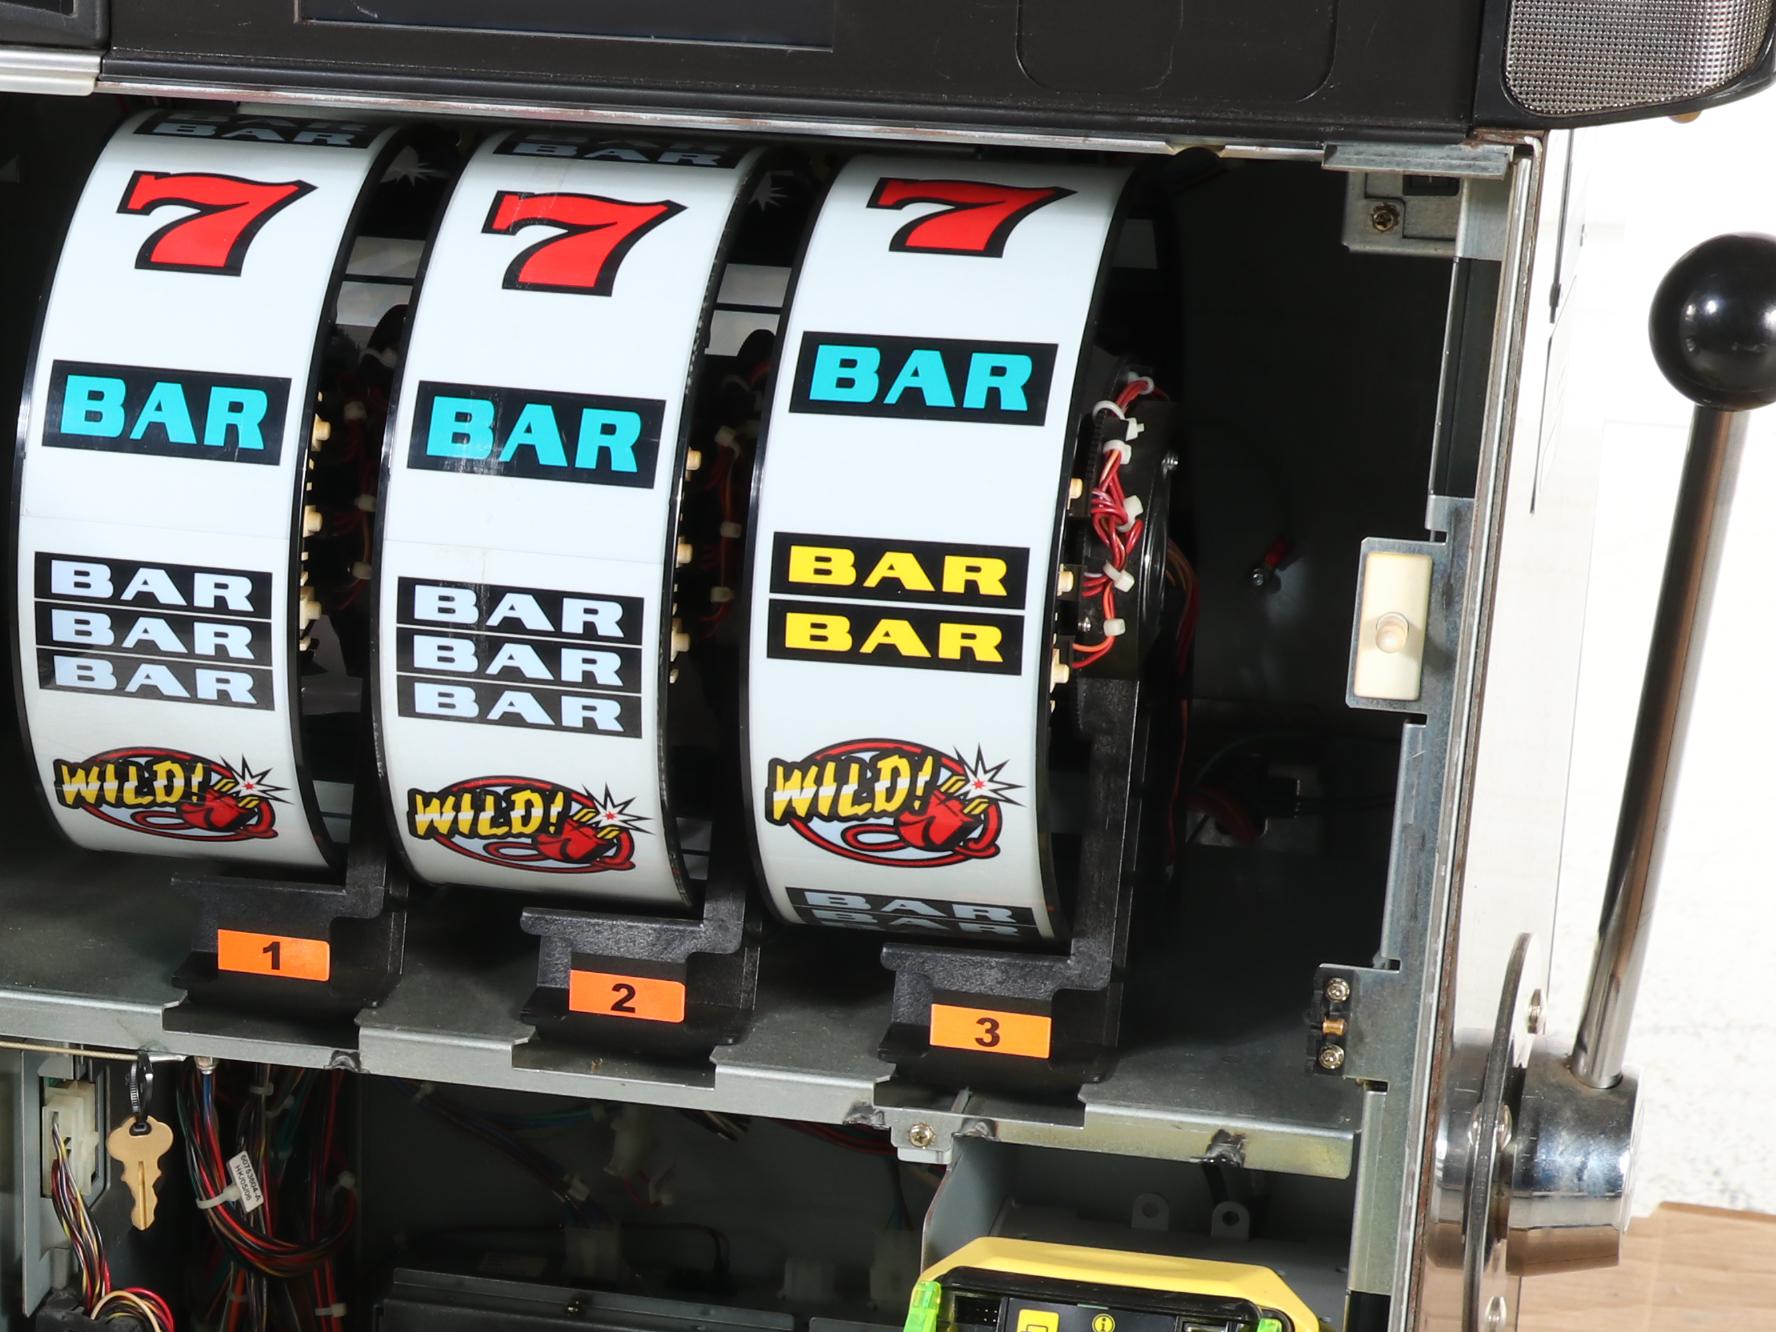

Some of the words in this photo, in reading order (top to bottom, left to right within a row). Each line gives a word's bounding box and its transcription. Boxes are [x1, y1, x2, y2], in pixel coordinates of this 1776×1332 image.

[153, 121, 368, 148] BAR
[510, 141, 719, 167] BAR
[116, 169, 318, 276] 7
[481, 190, 687, 297] 7
[866, 177, 1078, 258] 7
[809, 344, 1033, 411] BAR
[60, 374, 267, 452] BAR
[426, 395, 642, 473] BAR
[50, 559, 252, 612] BAR
[788, 544, 1008, 595] BAR
[50, 607, 252, 659] BAR
[414, 584, 624, 636] BAR
[414, 632, 624, 687] BAR
[783, 612, 1002, 666] BAR
[53, 653, 258, 705] BAR
[414, 679, 624, 733] BAR
[55, 757, 205, 812] WILD!
[765, 754, 935, 825] WILD!
[409, 789, 566, 844] WILD!
[804, 891, 1017, 923] BAR
[263, 942, 282, 970] 1
[611, 984, 637, 1012] 2
[974, 1017, 1000, 1047] 3
